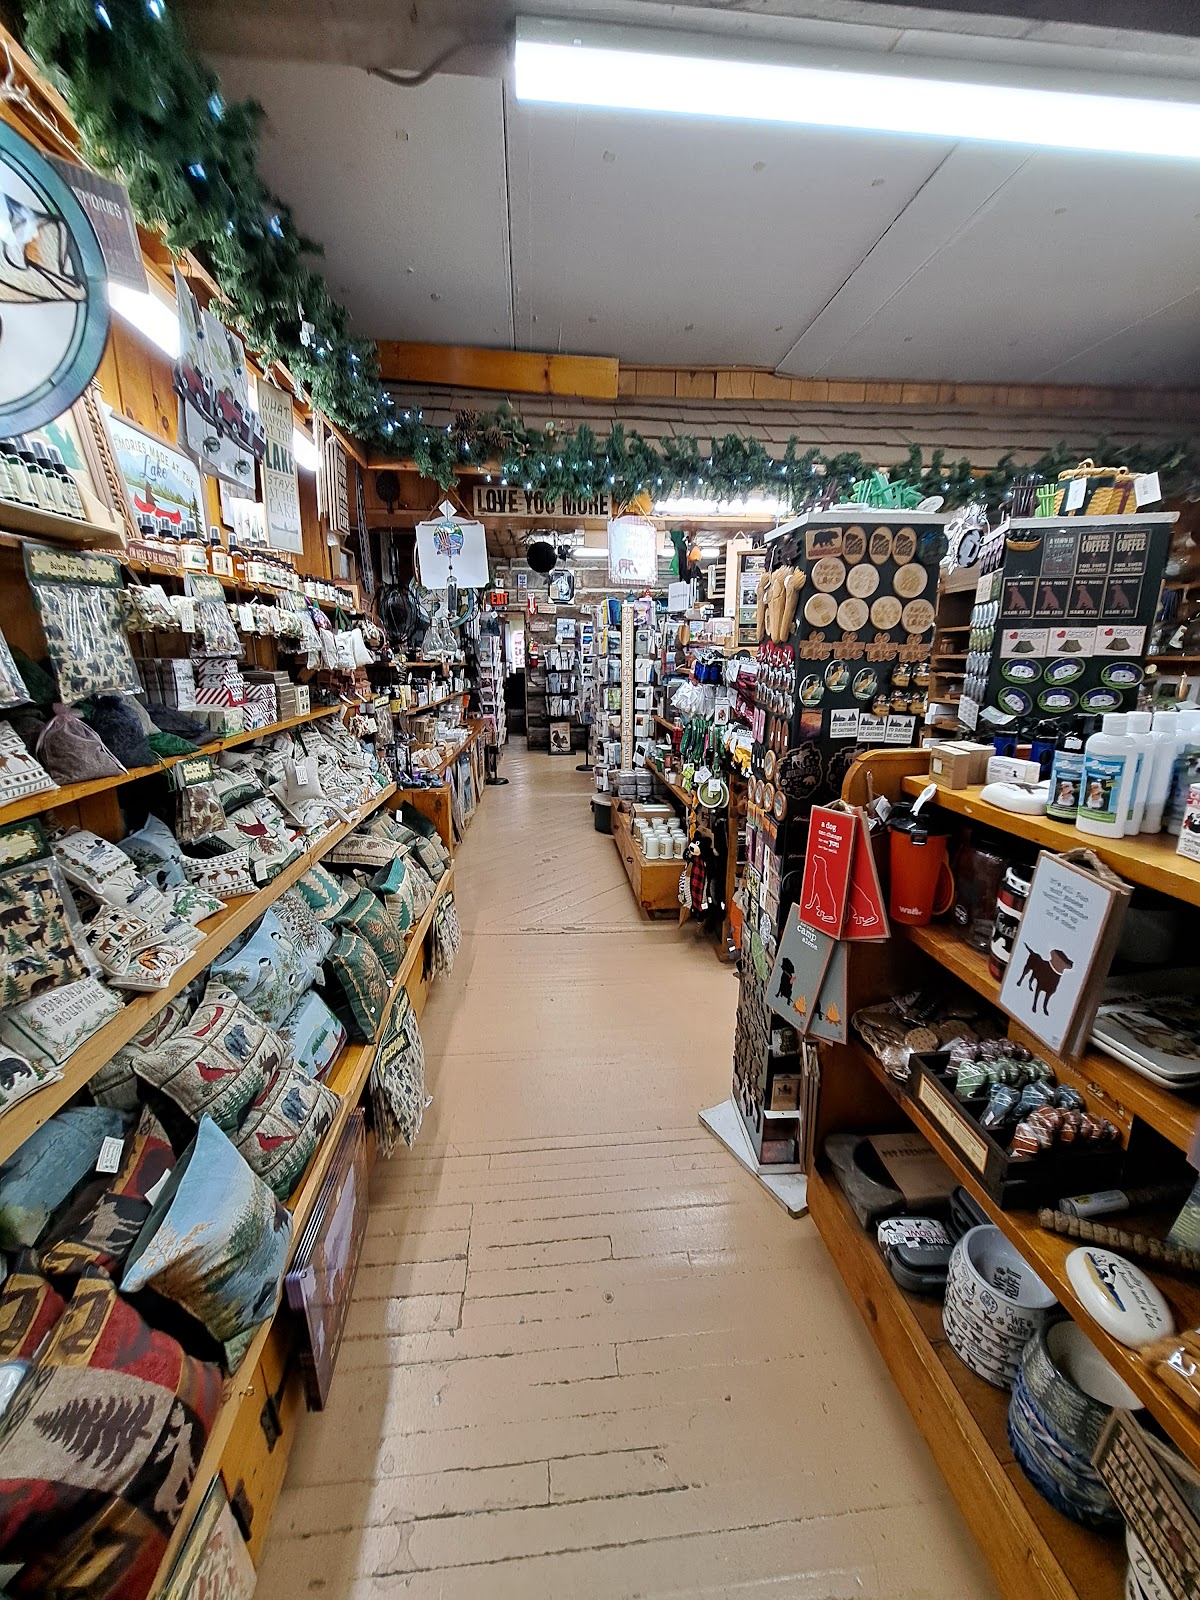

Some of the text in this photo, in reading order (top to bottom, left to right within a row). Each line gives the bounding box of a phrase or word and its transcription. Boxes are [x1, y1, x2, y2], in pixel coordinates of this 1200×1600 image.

[261, 395, 290, 416] WHAT
[264, 440, 294, 475] LAKE
[140, 454, 168, 481] Lake
[172, 461, 180, 473] AT
[268, 474, 295, 493] STAYS
[477, 488, 519, 513] LOVE
[270, 499, 297, 520] LAKE
[1081, 540, 1110, 553] COFFEE
[1117, 539, 1146, 552] COFFEE
[491, 592, 508, 605] EXIT
[826, 821, 837, 832] dog
[829, 840, 839, 848] you
[797, 924, 817, 941] camp
[52, 988, 105, 1026] MOUNTAINS
[992, 1273, 1005, 1290] WE
